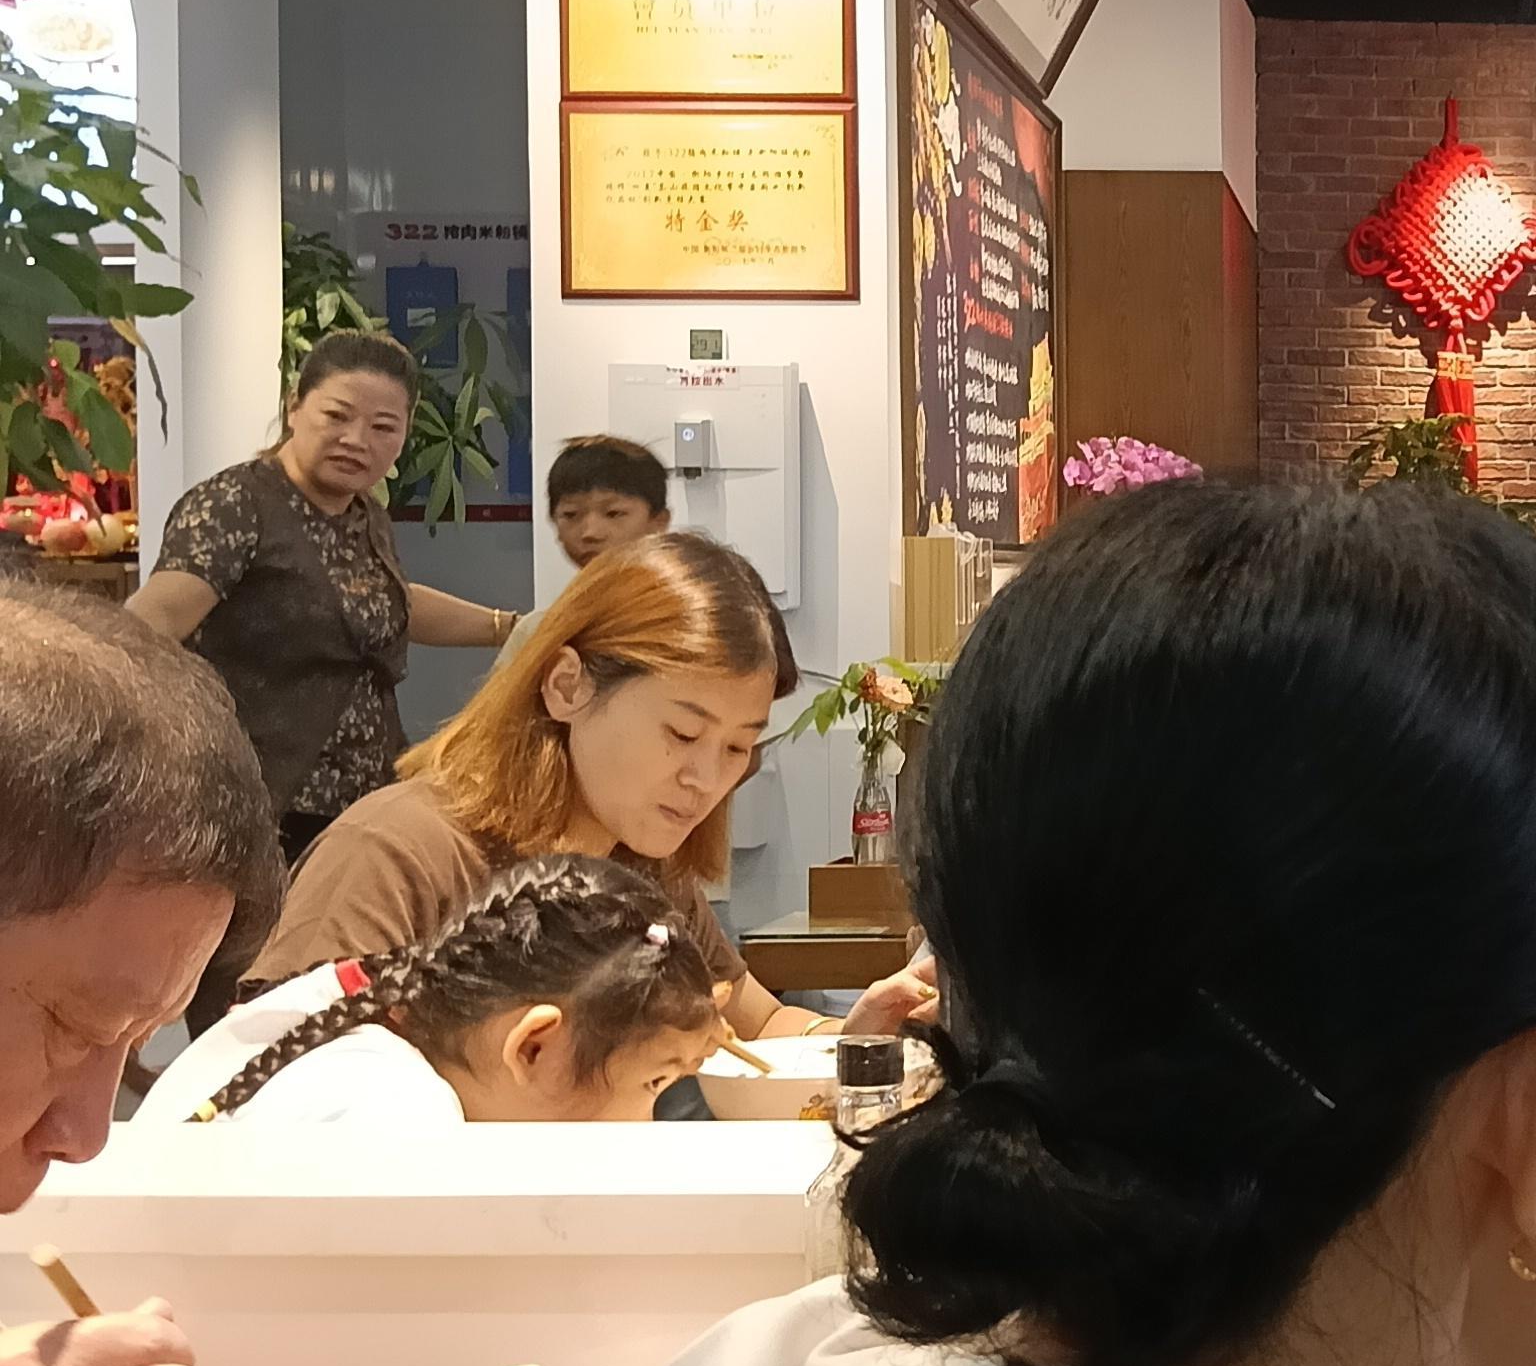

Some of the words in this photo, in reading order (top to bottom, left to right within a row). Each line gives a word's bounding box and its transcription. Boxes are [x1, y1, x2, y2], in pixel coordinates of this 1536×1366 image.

[665, 208, 749, 232] 特金奖
[385, 223, 439, 240] 322
